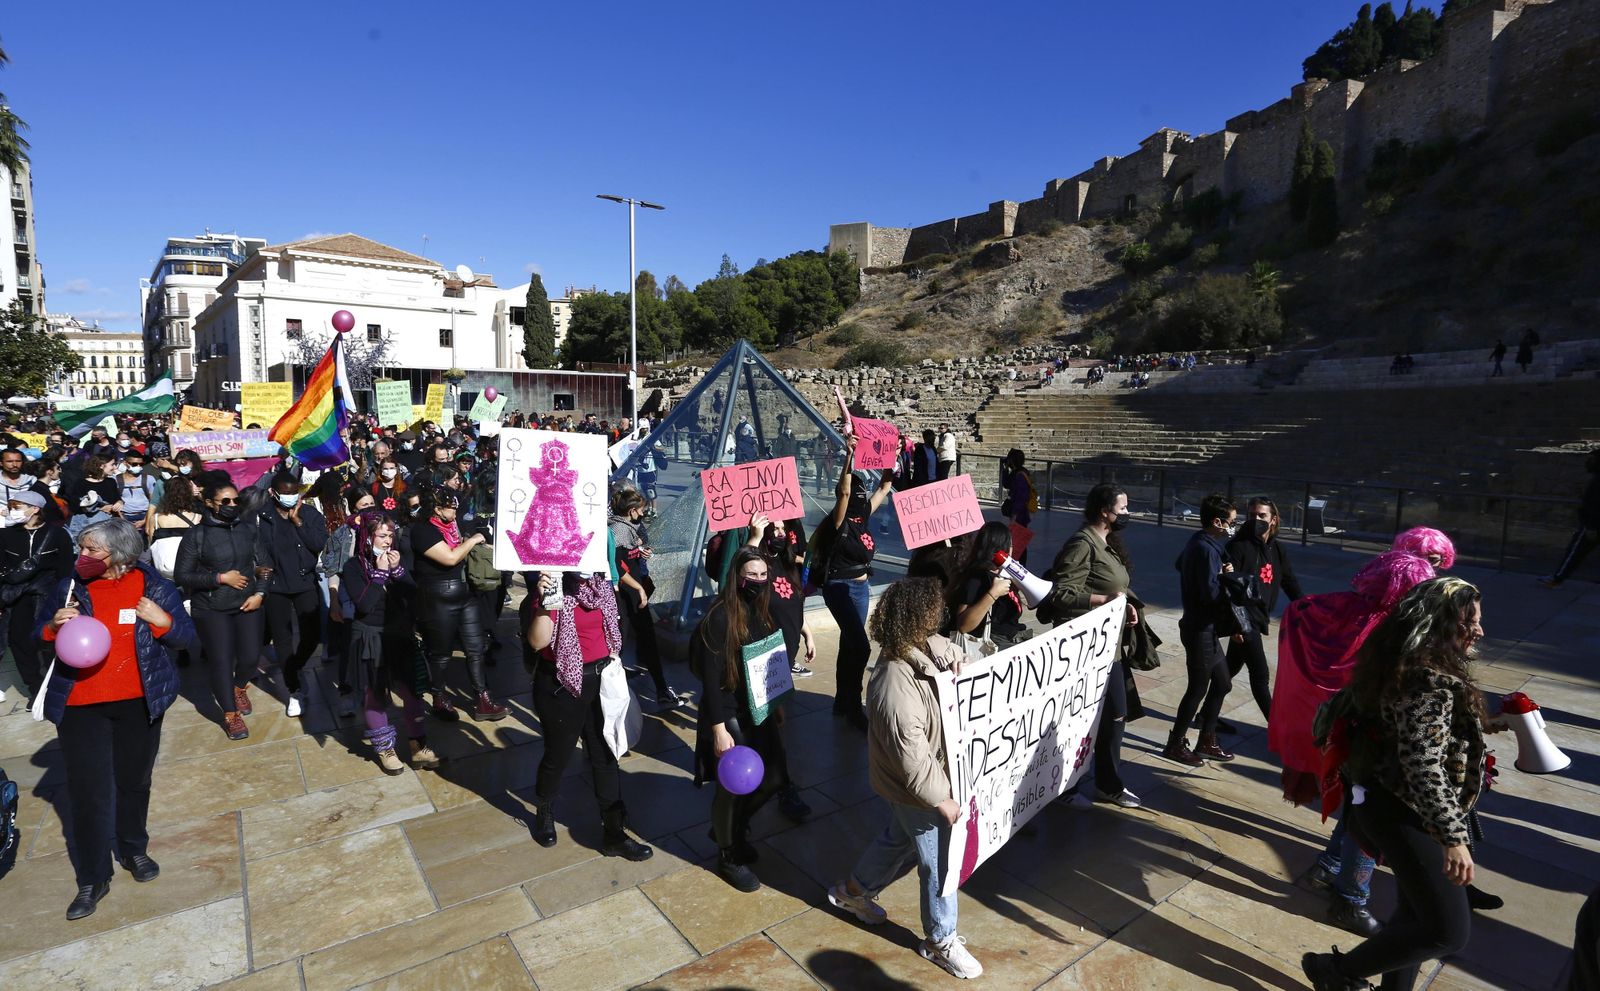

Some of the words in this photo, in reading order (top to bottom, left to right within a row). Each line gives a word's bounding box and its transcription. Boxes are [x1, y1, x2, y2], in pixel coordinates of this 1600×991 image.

[175, 444, 223, 456] TMBIEN
[225, 442, 243, 452] SON
[707, 470, 734, 494] LA
[739, 462, 784, 492] INVI
[711, 493, 736, 522] SE
[740, 488, 797, 515] QUEDA
[896, 483, 971, 516] RESISTENCIA
[907, 508, 976, 542] FEMINISTA
[1003, 784, 1046, 828] invisible
